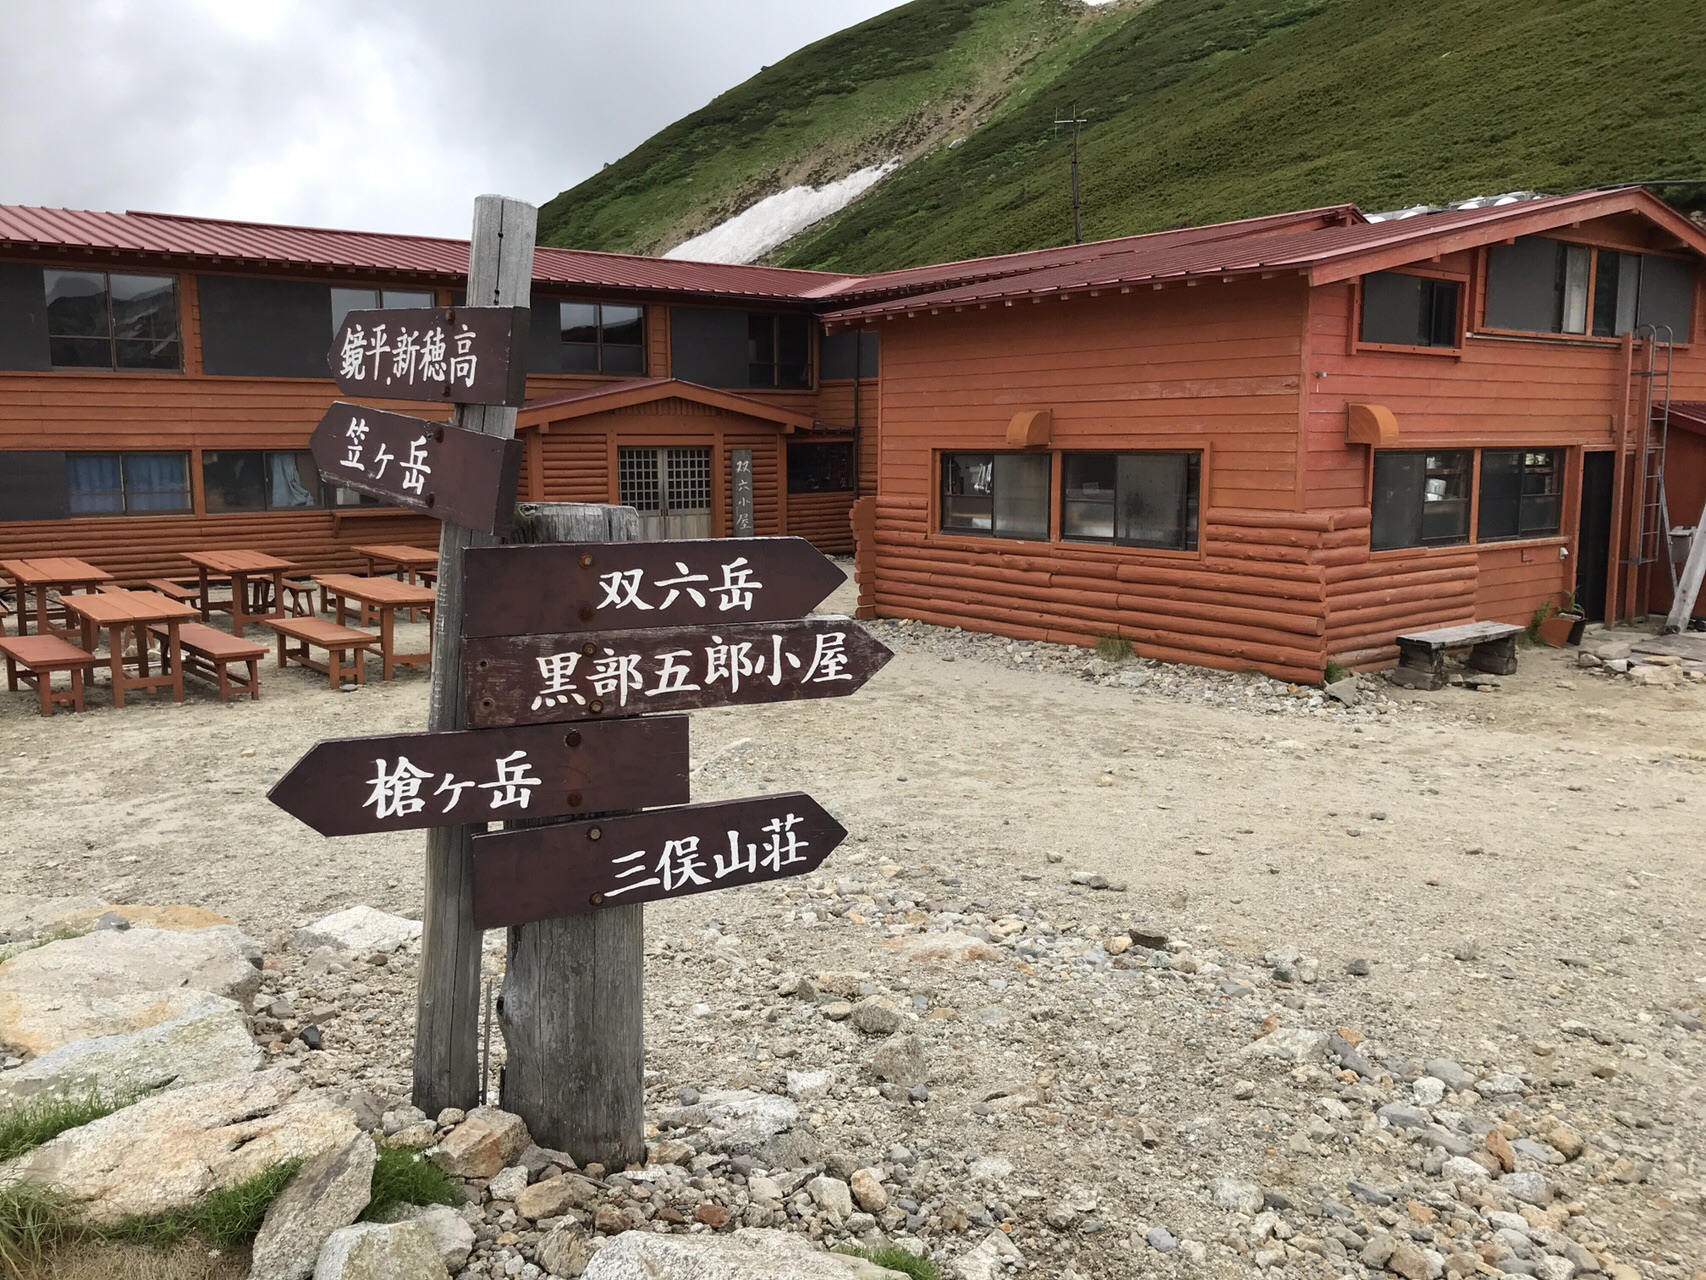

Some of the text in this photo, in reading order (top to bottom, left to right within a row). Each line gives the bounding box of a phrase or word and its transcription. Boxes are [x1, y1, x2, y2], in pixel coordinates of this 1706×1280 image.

[736, 460, 752, 530] 双六小屋
[596, 557, 763, 612] 双六岳
[531, 631, 853, 711] 黒部五郎小屋
[603, 813, 809, 897] 三俣山荘
